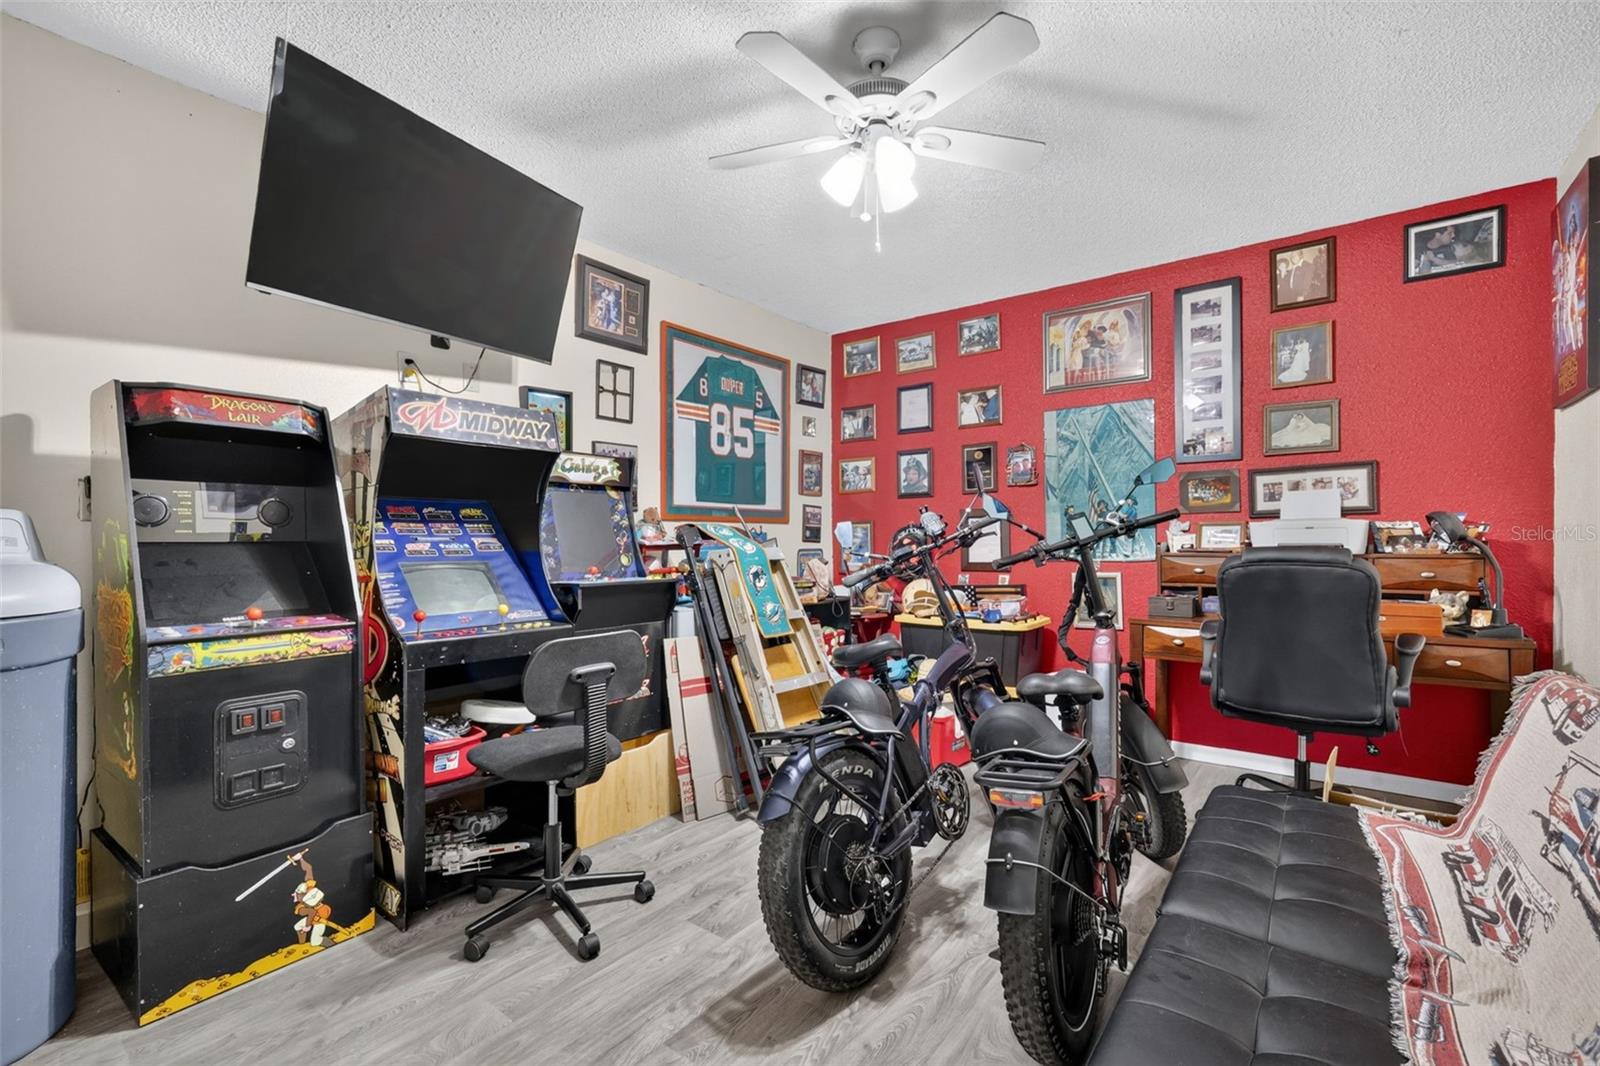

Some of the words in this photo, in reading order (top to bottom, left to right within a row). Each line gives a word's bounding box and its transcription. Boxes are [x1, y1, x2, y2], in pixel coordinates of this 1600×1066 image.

[700, 378, 708, 396] 8
[755, 391, 763, 408] 5
[228, 411, 264, 427] LAIR
[458, 411, 549, 441] MIDWAY
[711, 403, 754, 459] 85
